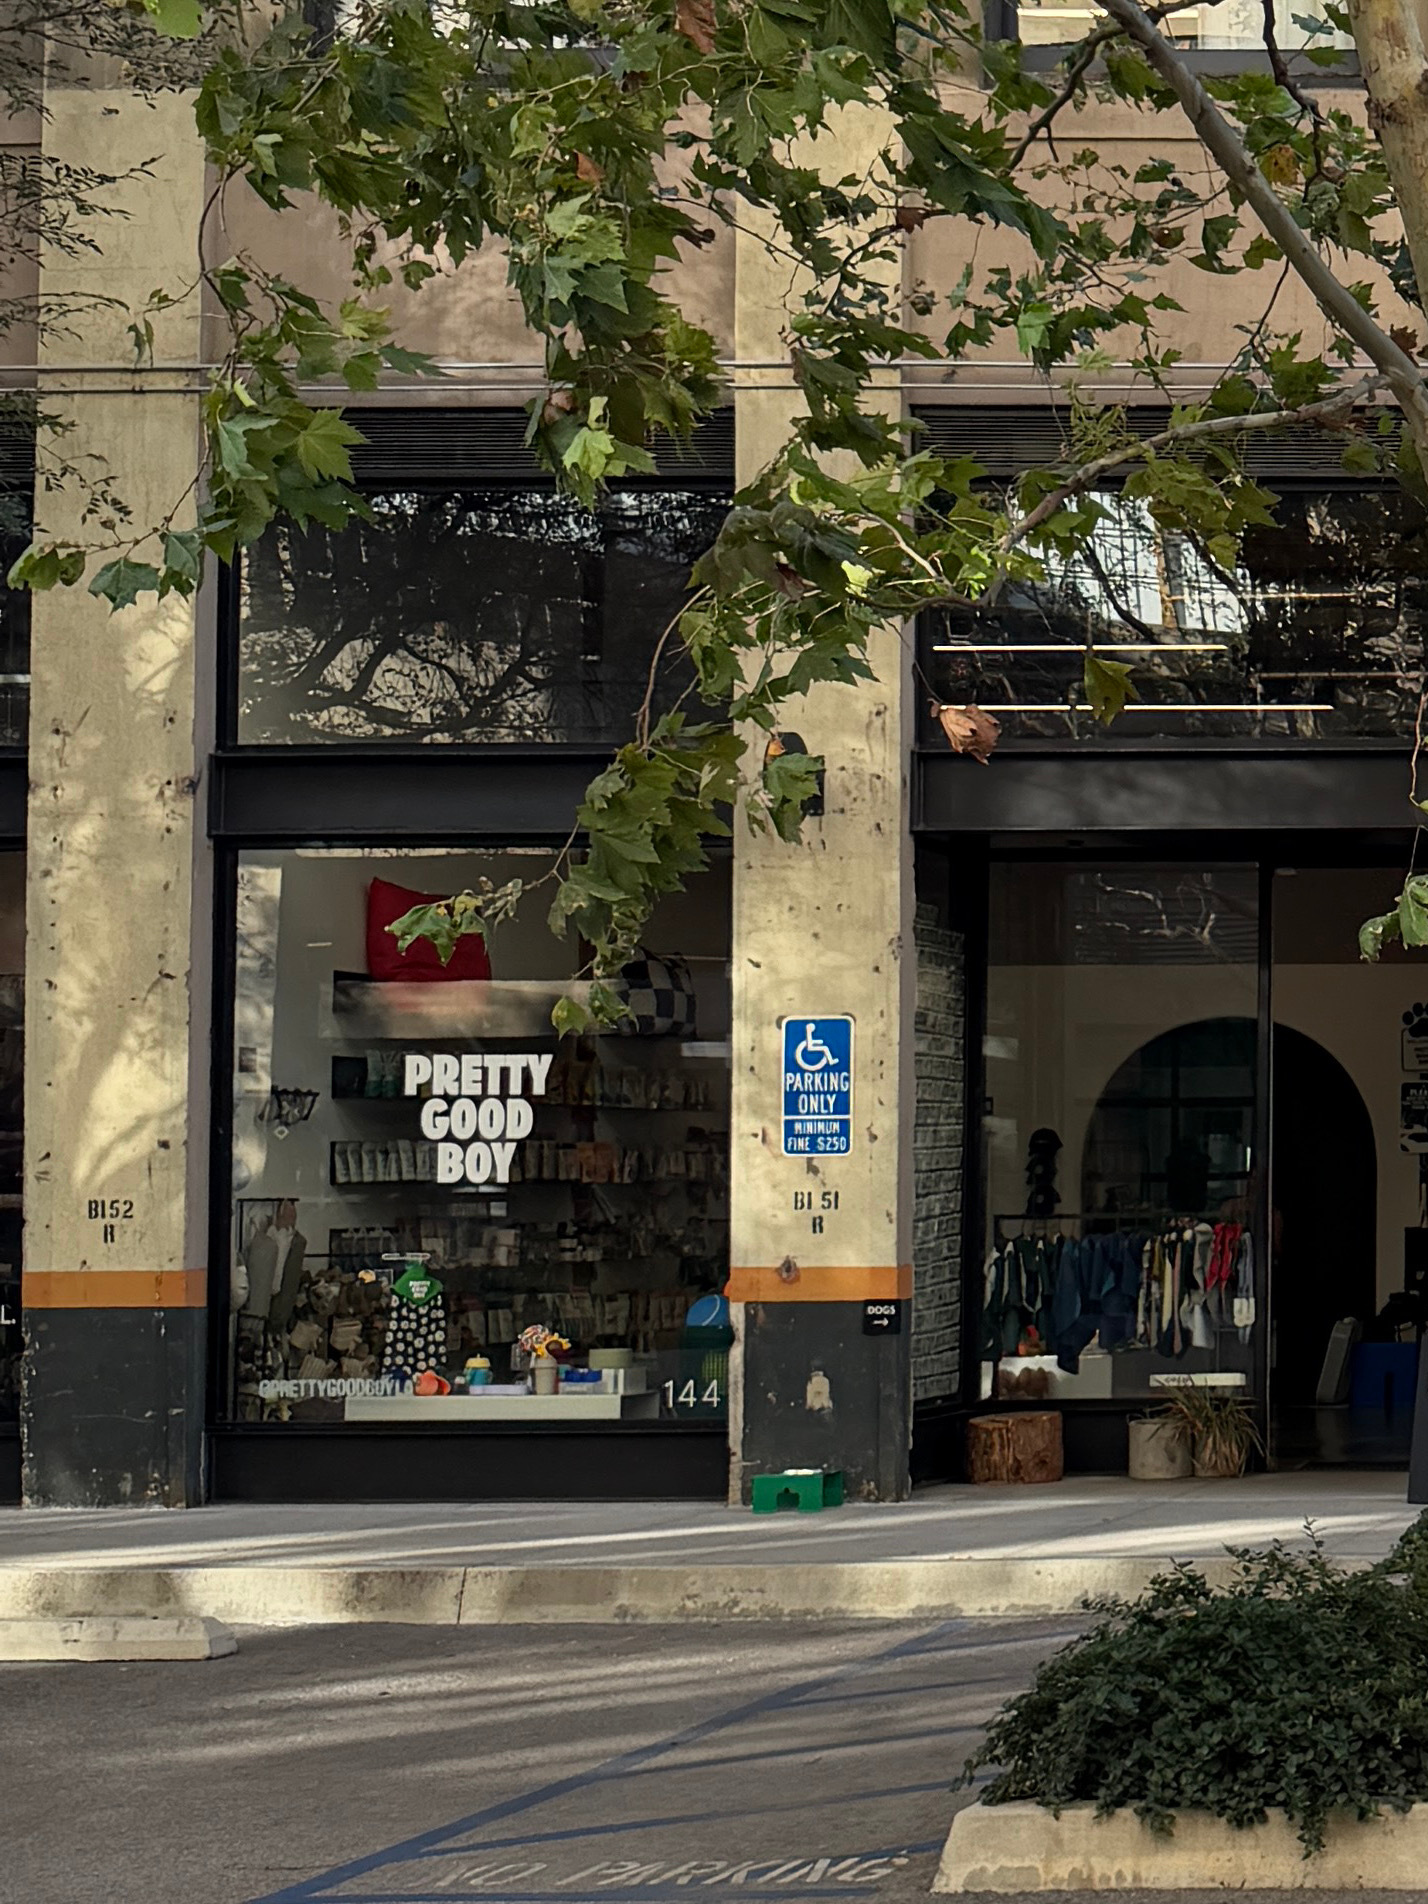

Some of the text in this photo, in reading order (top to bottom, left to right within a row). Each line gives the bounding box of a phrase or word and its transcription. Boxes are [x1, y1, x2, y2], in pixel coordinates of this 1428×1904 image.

[404, 1054, 554, 1096] PRETTY
[786, 1072, 849, 1092] PARKING
[798, 1094, 837, 1114] ONLY
[420, 1098, 534, 1140] GOOD
[794, 1121, 840, 1135] MINIMUM
[787, 1137, 811, 1151] FINE
[436, 1142, 518, 1184] BOY
[867, 1305, 896, 1315] DOGS
[662, 1379, 721, 1408] 144
[554, 1854, 910, 1886] PARKING
